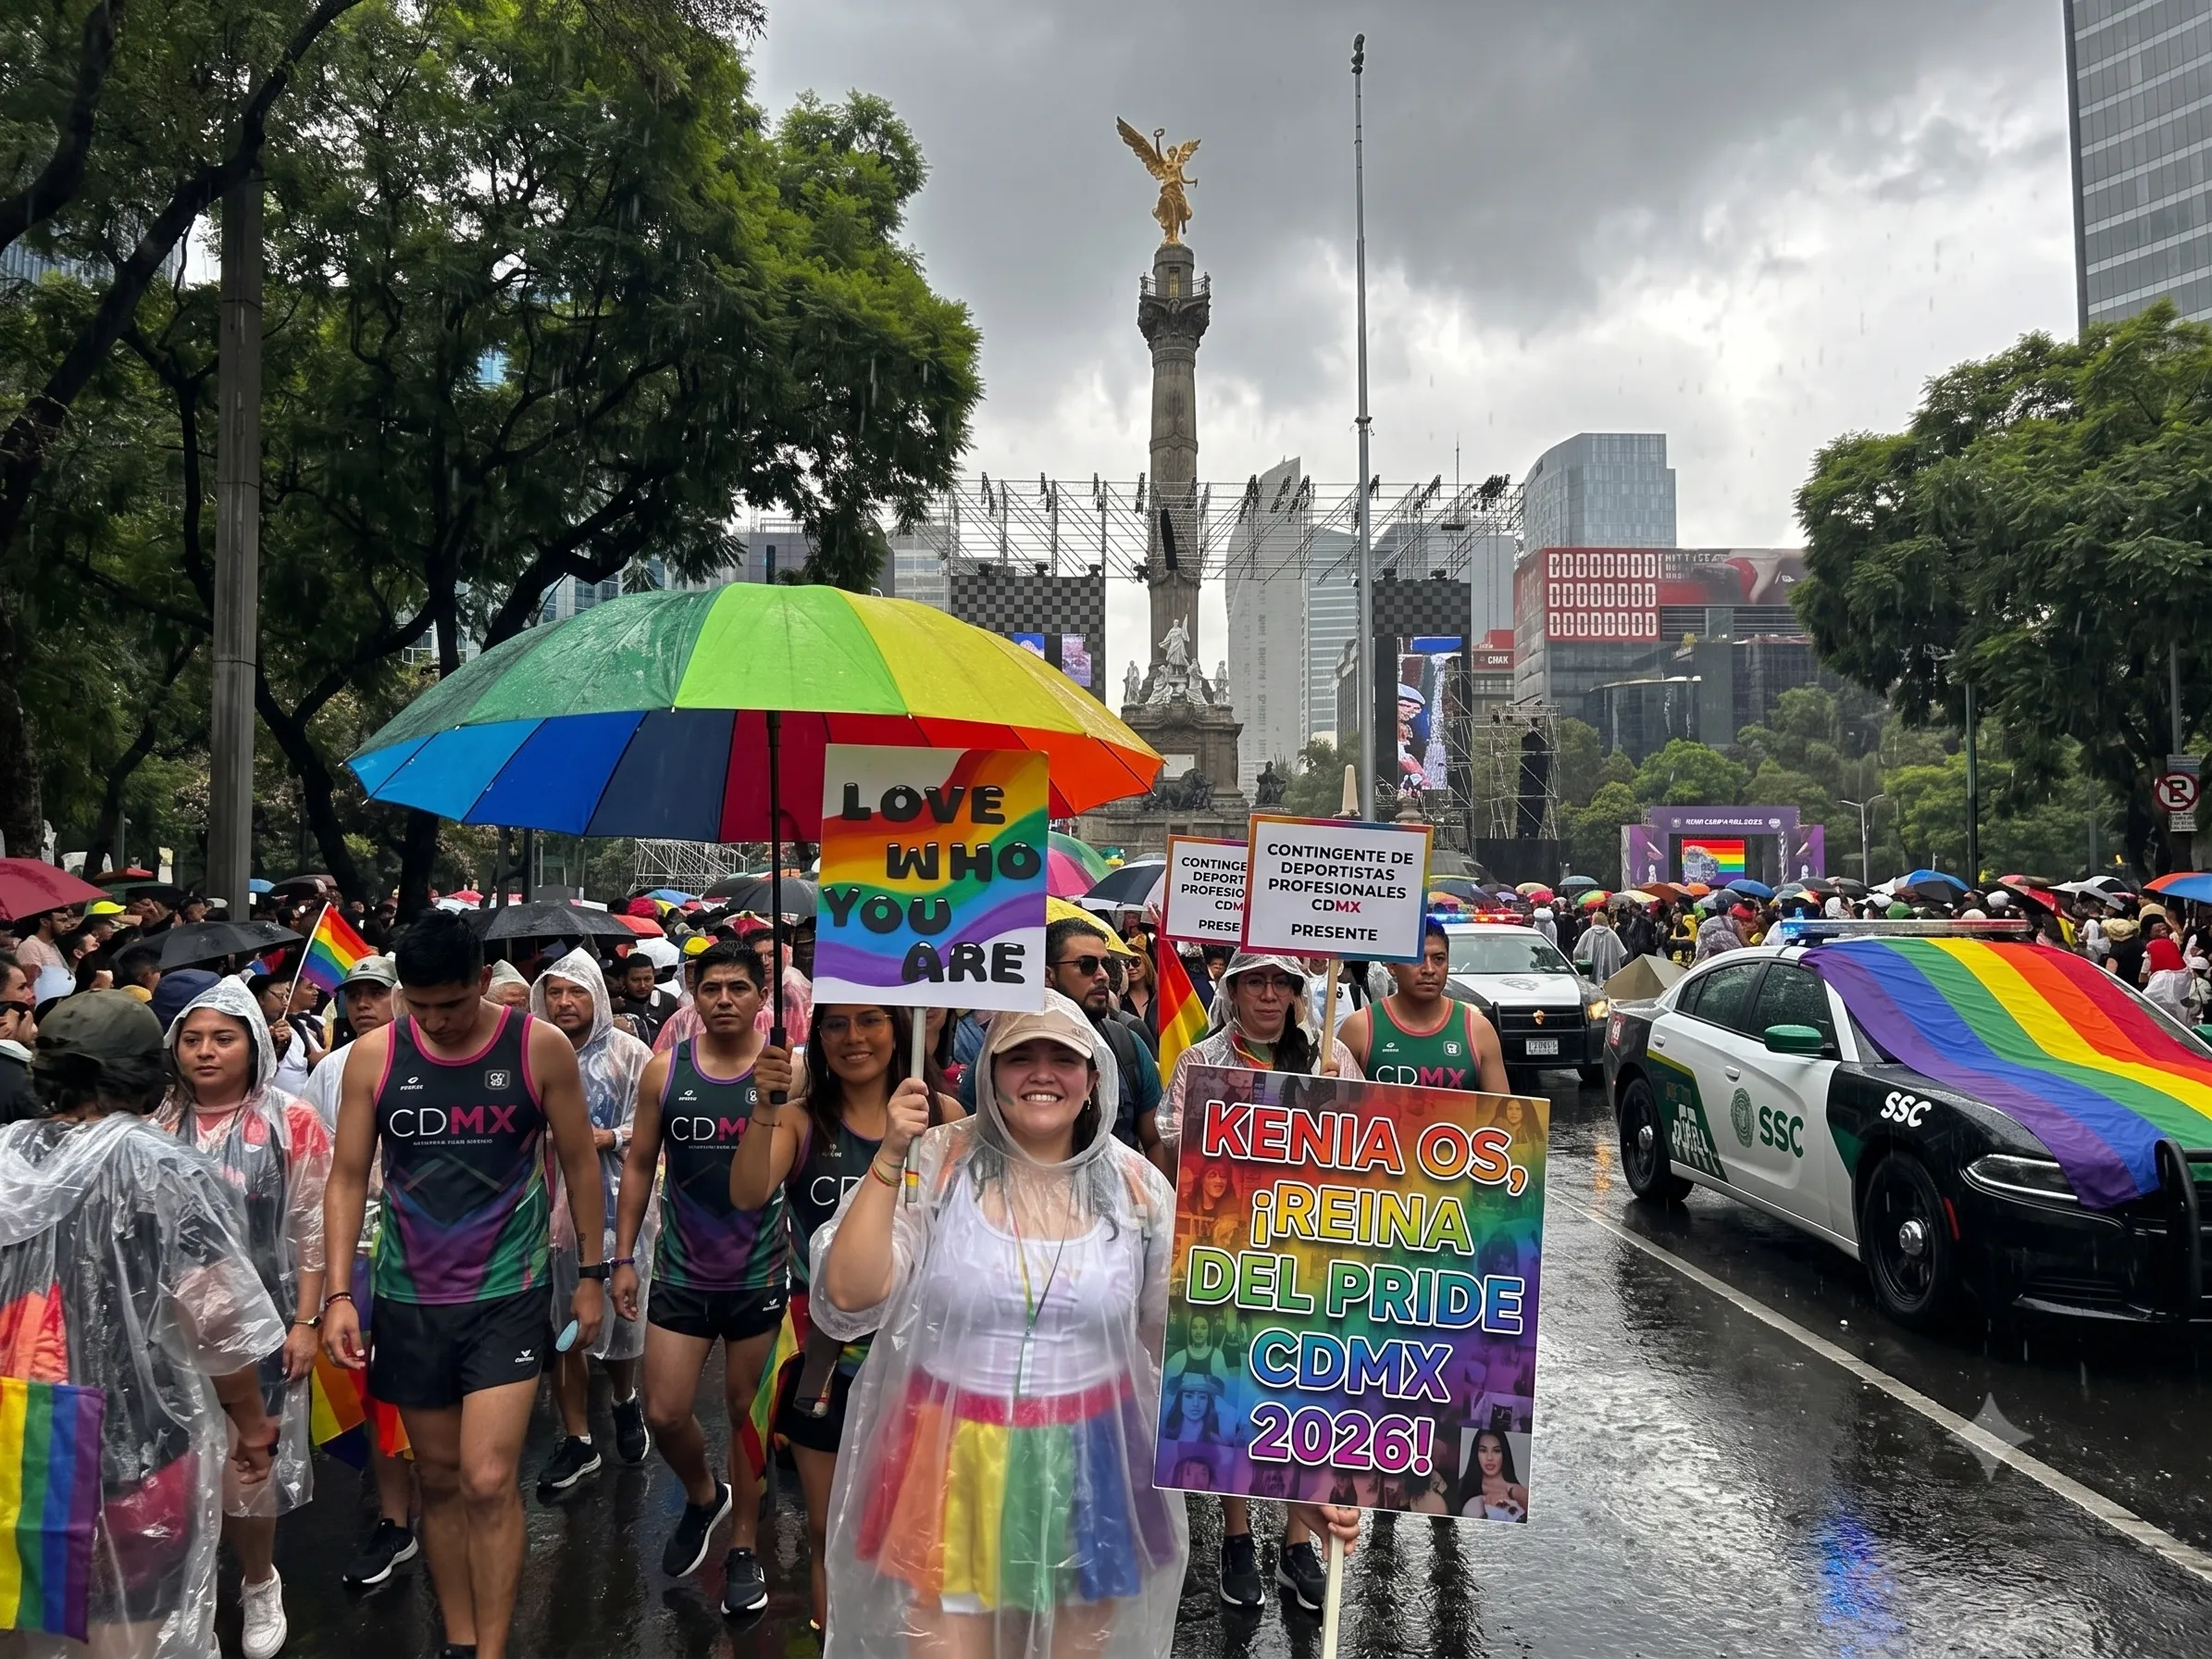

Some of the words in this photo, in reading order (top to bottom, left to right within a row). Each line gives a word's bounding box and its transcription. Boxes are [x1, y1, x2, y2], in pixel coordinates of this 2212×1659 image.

[841, 782, 1006, 825] LOVE
[886, 842, 1042, 880] WHO
[1181, 856, 1248, 871] CONTINGE
[1267, 843, 1386, 864] CONTINGENTE
[1391, 852, 1414, 865] DE
[1193, 871, 1246, 885] DEPORT
[1281, 862, 1396, 881] DEPORTISTAS
[1181, 883, 1245, 898] PROFESIO
[1268, 879, 1407, 899] PROFESIONALES
[822, 886, 952, 936] YOU
[1214, 900, 1244, 912] CDM
[1311, 898, 1361, 914] CDMX
[1198, 919, 1241, 932] PRESE
[1291, 923, 1378, 942] PRESENTE
[901, 941, 1026, 984] ARE
[1375, 1066, 1466, 1089] CDMX
[389, 1105, 518, 1138] CDMX
[1880, 1091, 1932, 1129] SSC
[1202, 1099, 1405, 1177] KENIA
[1416, 1124, 1529, 1197] OS,
[1758, 1105, 1805, 1158] SSC
[1250, 1180, 1475, 1254] ¡REINA
[1186, 1245, 1314, 1315] DEL
[1326, 1260, 1525, 1336] PRIDE
[1249, 1328, 1453, 1403] CDMX
[1249, 1402, 1437, 1477] 2026!
